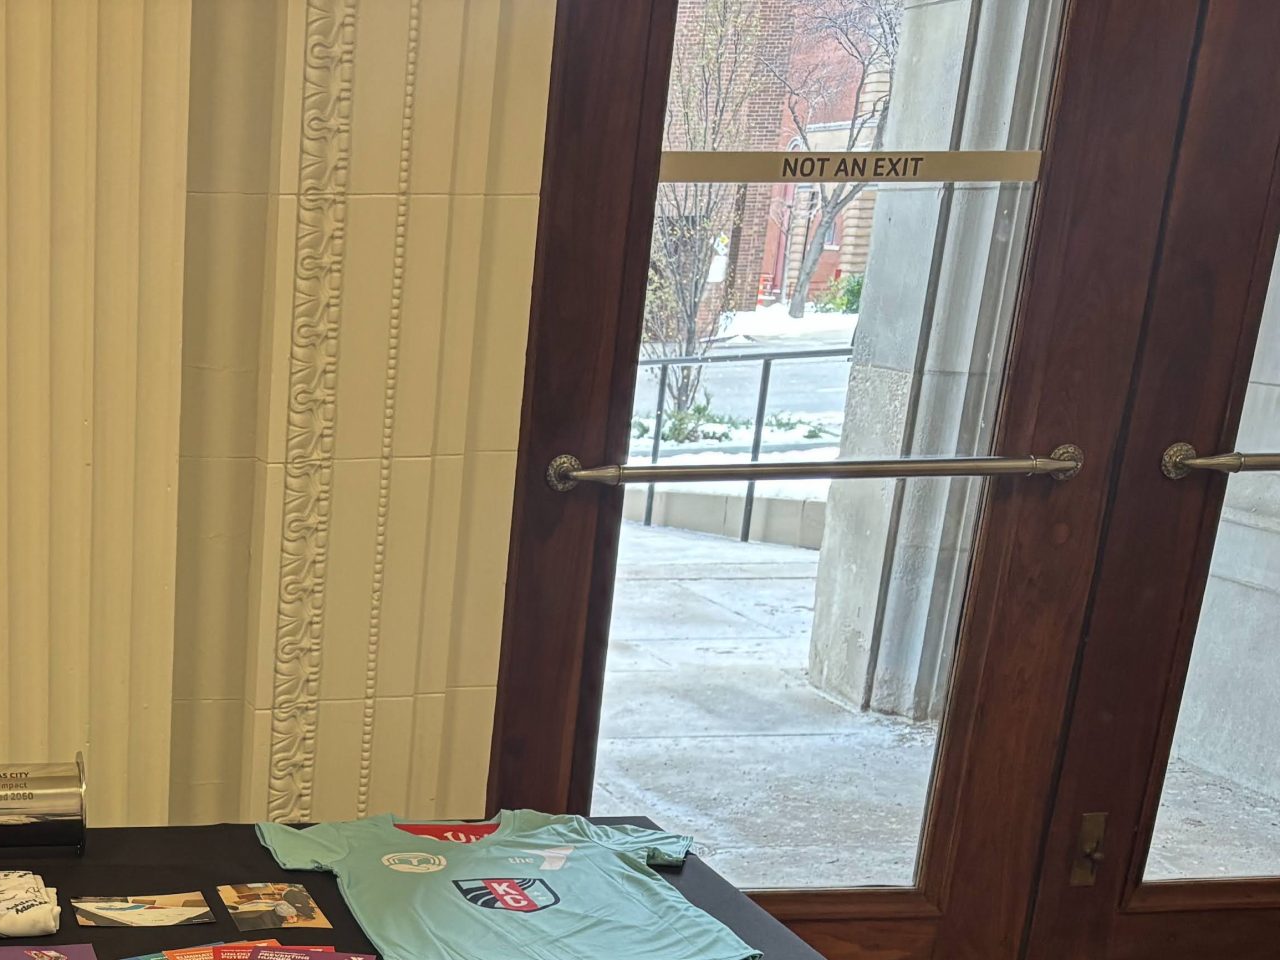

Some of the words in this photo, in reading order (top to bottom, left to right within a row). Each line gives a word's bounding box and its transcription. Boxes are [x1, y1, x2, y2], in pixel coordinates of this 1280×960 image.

[782, 158, 830, 177] NOT
[834, 158, 867, 177] AN
[873, 158, 924, 177] EXIT
[508, 856, 535, 865] the
